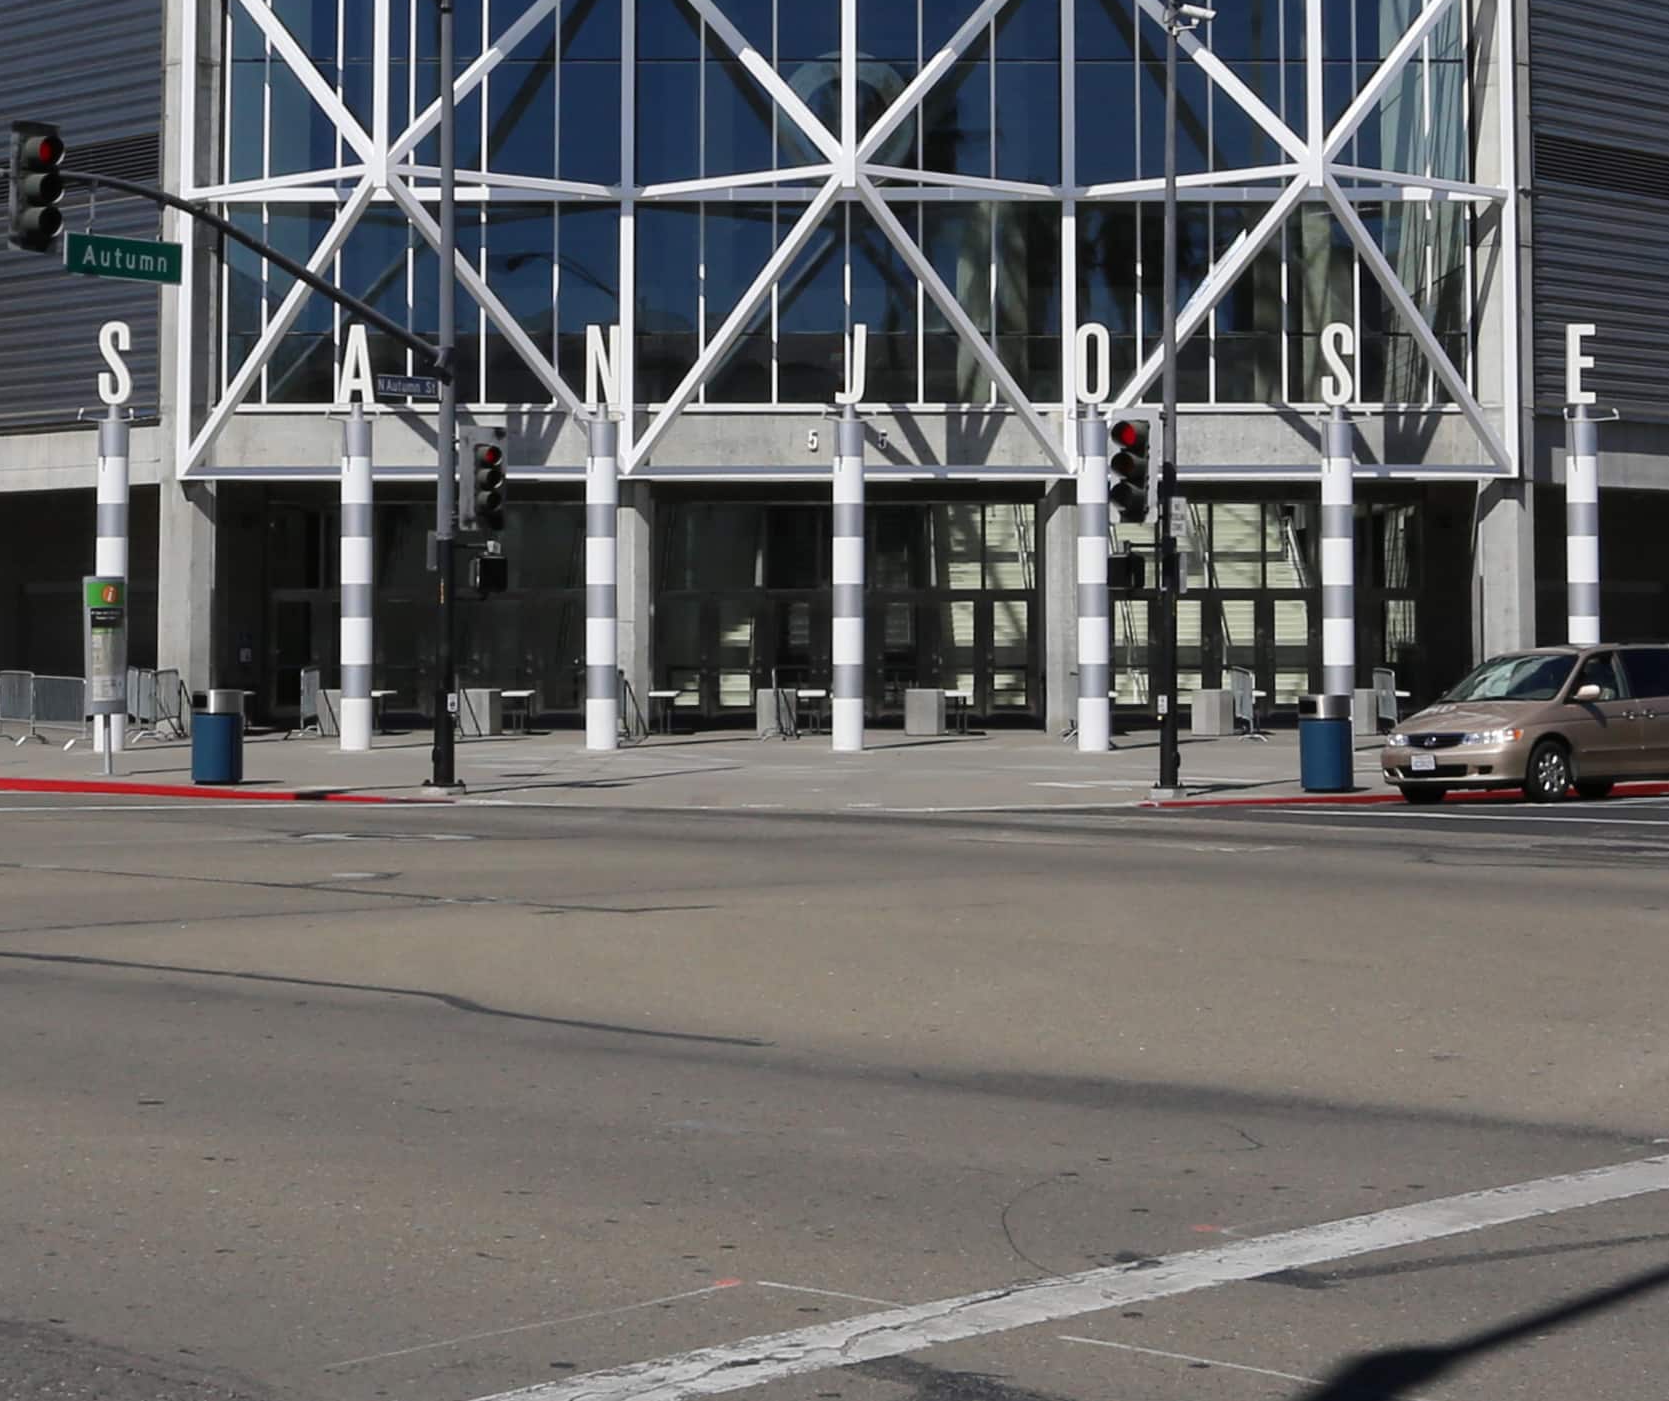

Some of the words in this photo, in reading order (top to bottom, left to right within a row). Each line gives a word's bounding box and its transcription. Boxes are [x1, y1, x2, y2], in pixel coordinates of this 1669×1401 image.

[81, 244, 169, 273] Autumn
[98, 321, 623, 406] SAN
[834, 321, 1597, 406] JOSE
